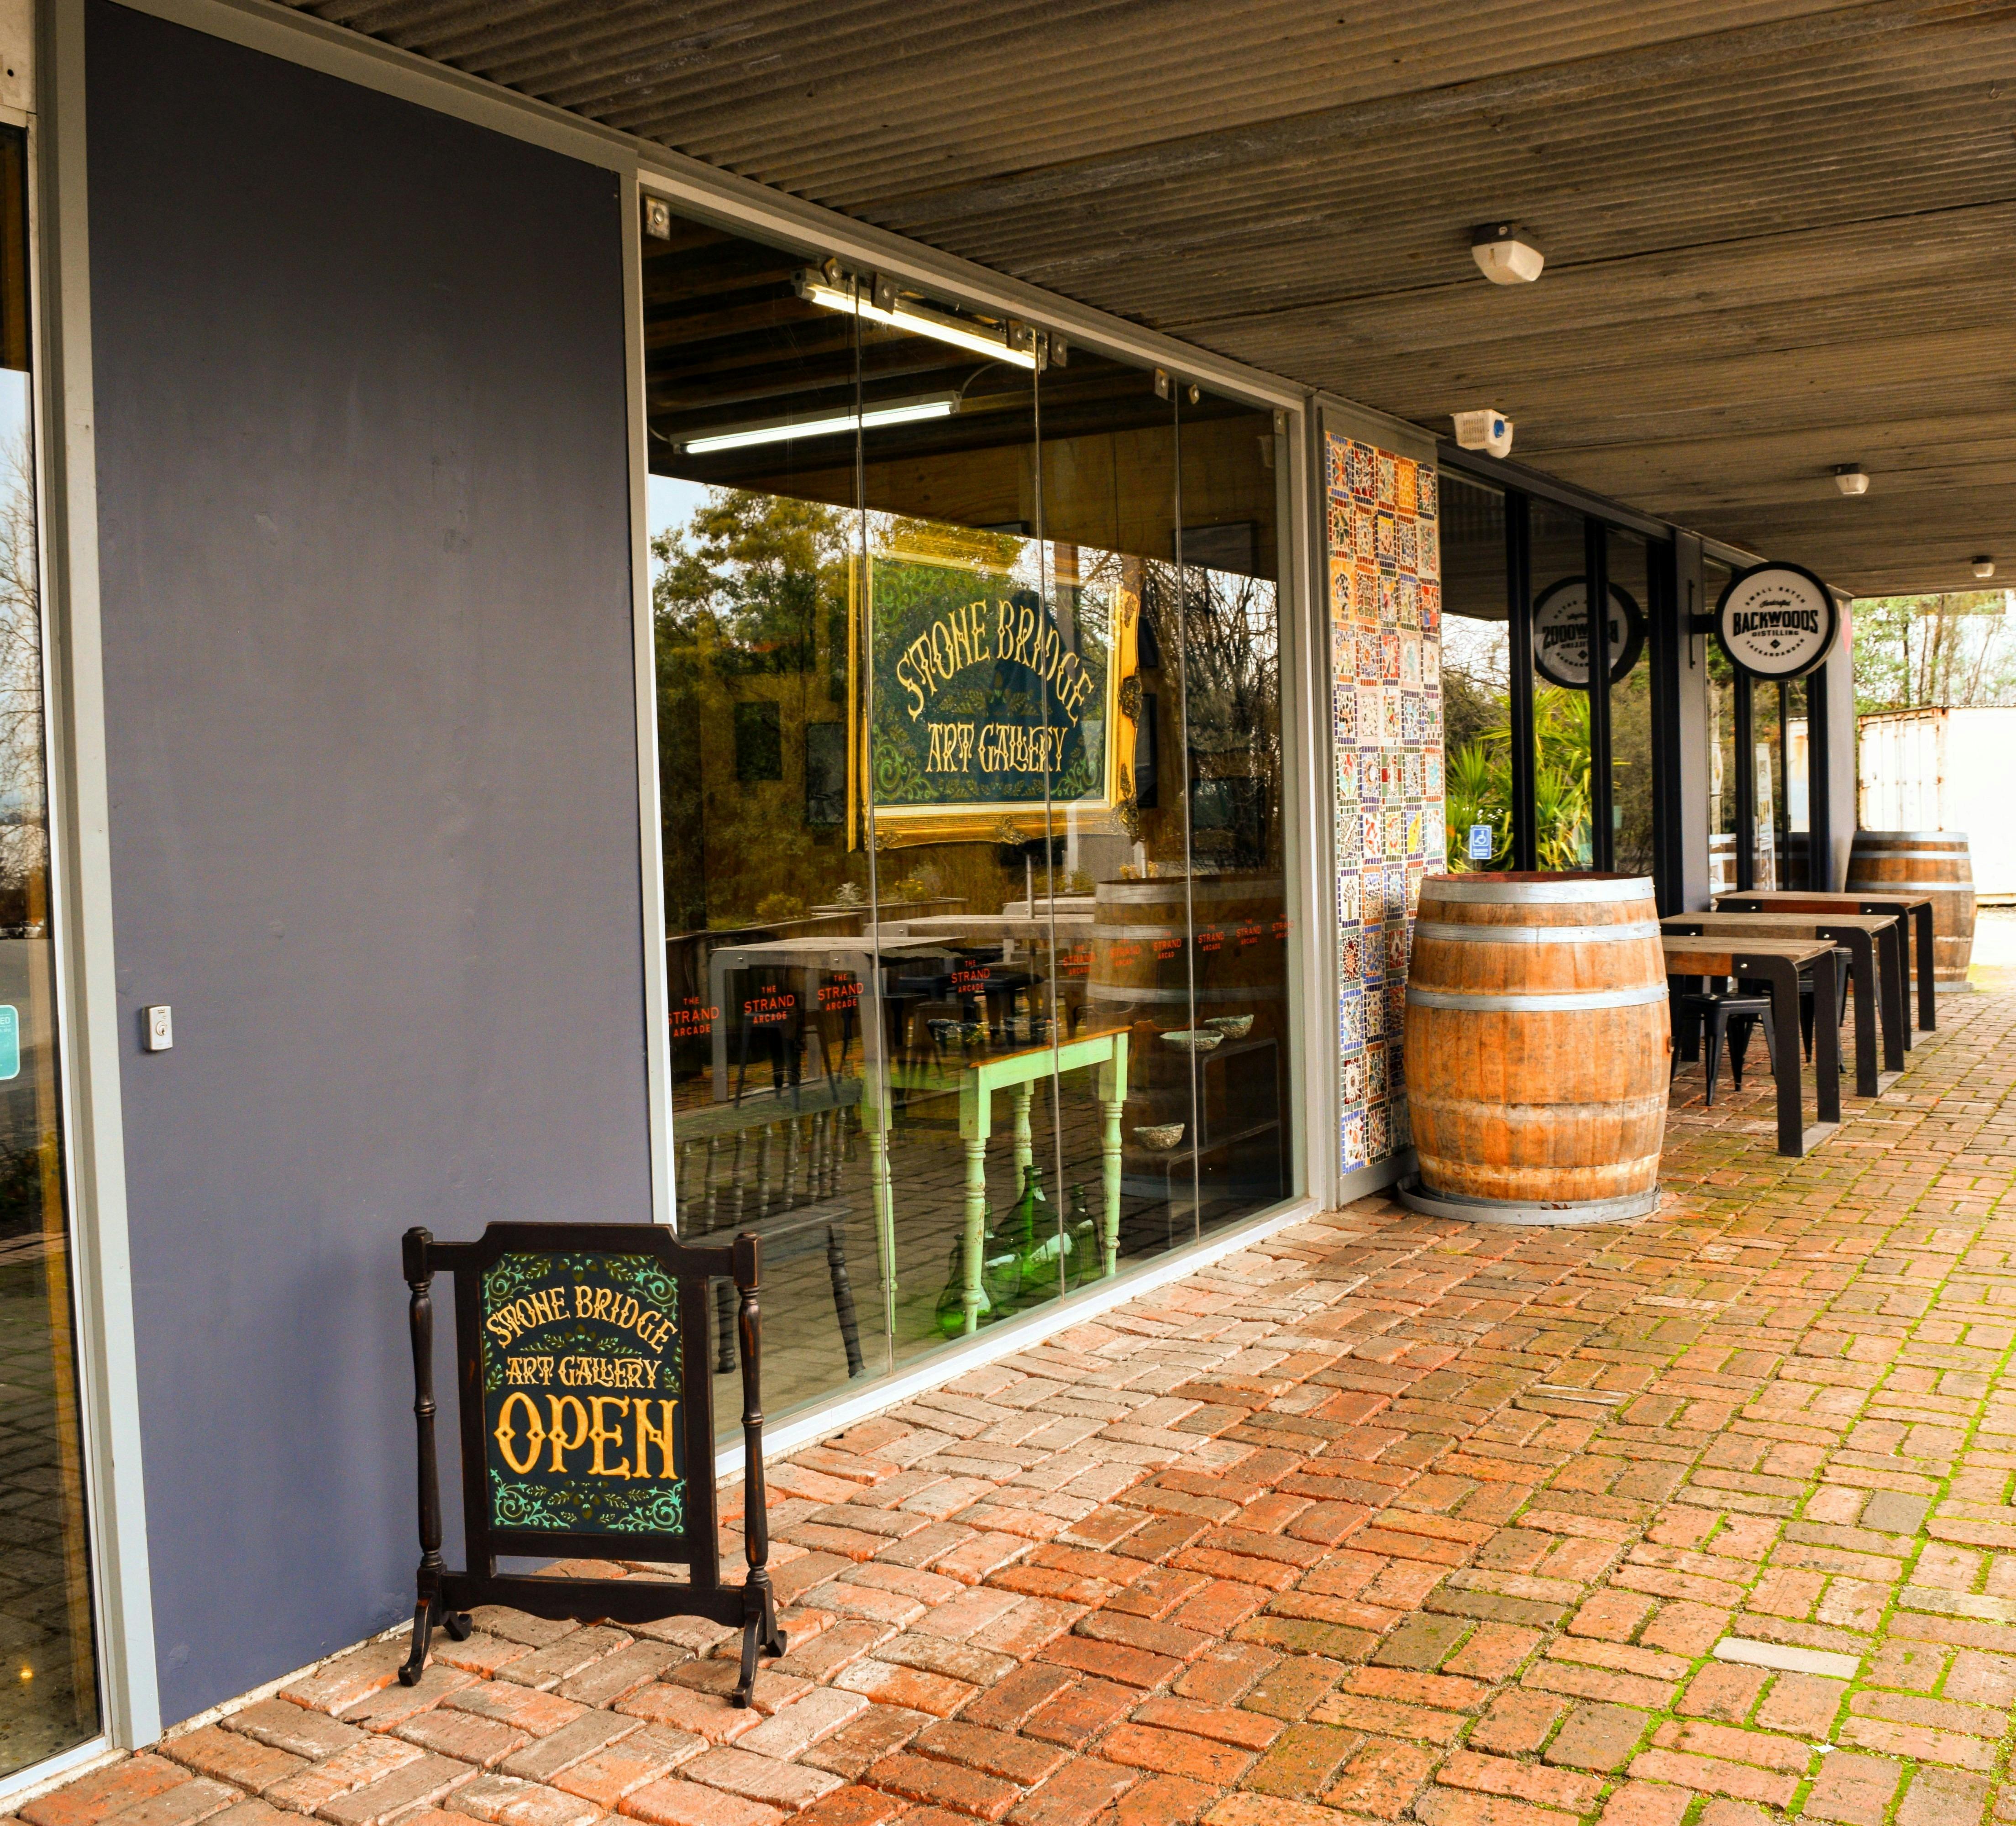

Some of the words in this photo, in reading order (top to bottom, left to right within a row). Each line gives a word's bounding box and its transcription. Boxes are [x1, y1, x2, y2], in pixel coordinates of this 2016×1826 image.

[1733, 610, 1818, 637] BACKWOODS
[897, 599, 991, 722] STONE
[996, 600, 1094, 727] BRIDGE
[925, 721, 974, 772] ART
[978, 721, 1068, 772] GALLERY
[1198, 932, 1224, 943] STRAND
[1236, 925, 1261, 938] STRAND
[1153, 939, 1181, 952] STRAND
[834, 974, 847, 982] THE
[951, 968, 990, 983] STRAND
[761, 985, 776, 993] THE
[818, 982, 864, 1001] STRAND
[958, 982, 984, 993] ARCADE
[683, 997, 699, 1005] THE
[744, 995, 795, 1013] STRAND
[826, 998, 857, 1011] ARCADE
[753, 1011, 787, 1024] ARCADE
[674, 1024, 711, 1037] ARCADE
[486, 1286, 570, 1349] STONE
[575, 1286, 678, 1354] BRIDGE
[506, 1356, 554, 1385] ART
[558, 1356, 662, 1389] GALLERY
[493, 1391, 679, 1480] OPEN
